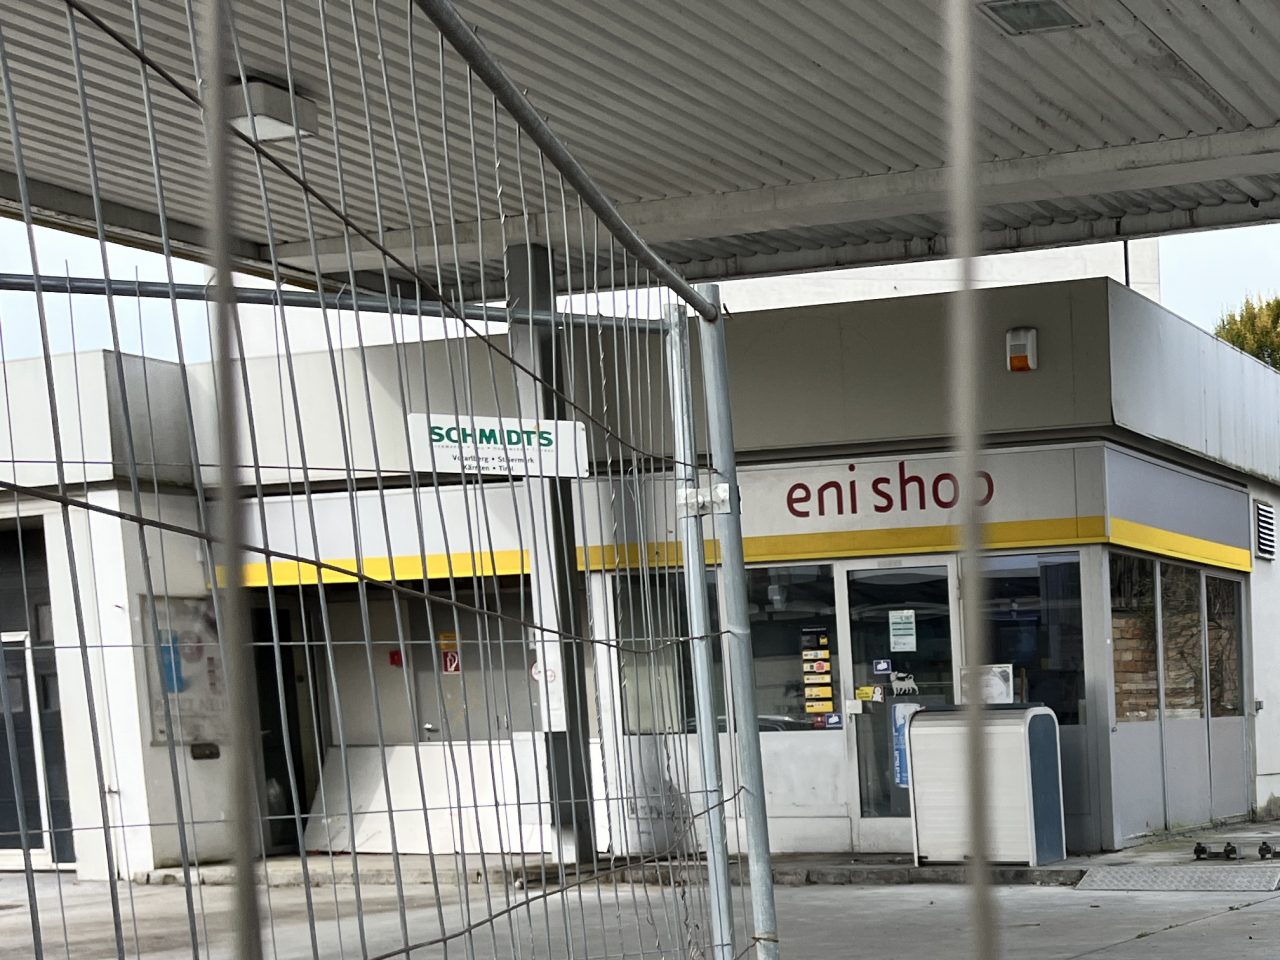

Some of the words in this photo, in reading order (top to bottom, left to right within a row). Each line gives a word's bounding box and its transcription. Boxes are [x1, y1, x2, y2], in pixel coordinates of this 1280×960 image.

[452, 454, 489, 463] Voarlbrg
[497, 456, 535, 464] Stiermrk
[463, 464, 490, 472] Kärnen
[498, 464, 514, 472] Tirl
[786, 463, 858, 518] eni
